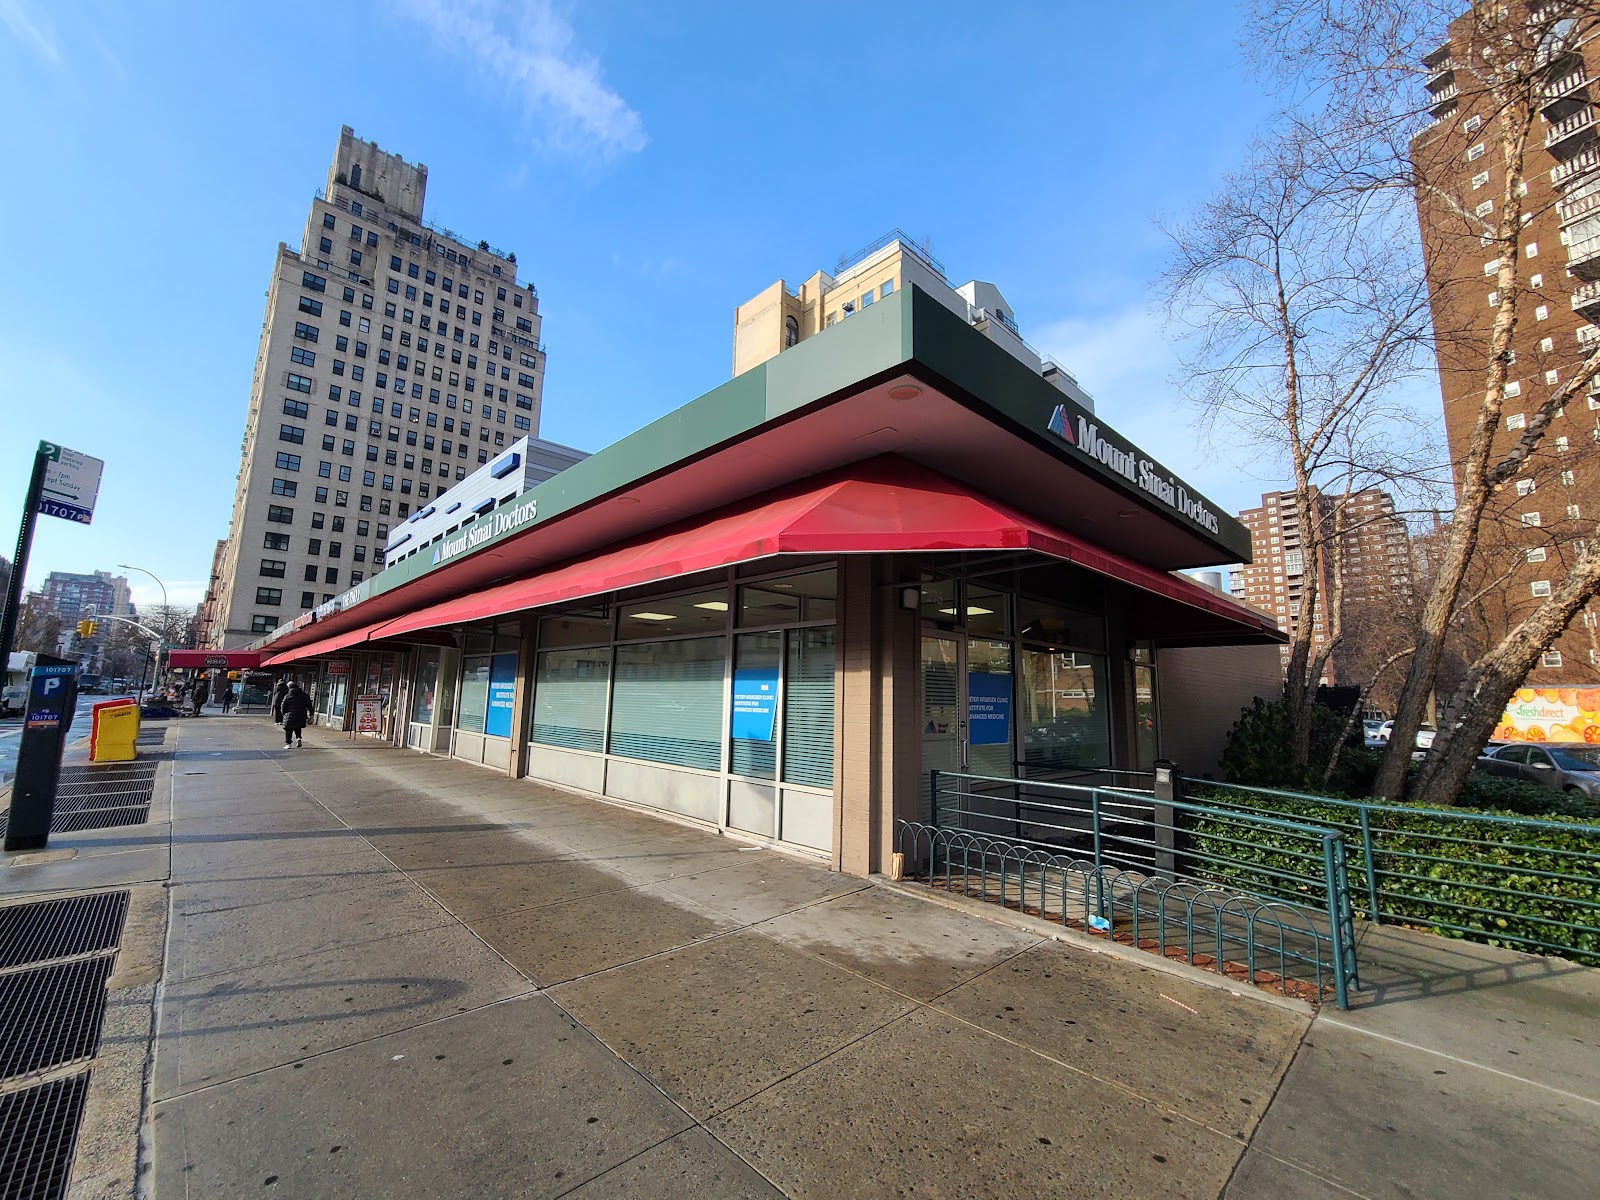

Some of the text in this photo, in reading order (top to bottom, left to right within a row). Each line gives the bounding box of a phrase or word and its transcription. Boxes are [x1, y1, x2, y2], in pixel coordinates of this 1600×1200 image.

[1077, 414, 1219, 535] Mount Sinai Doctors
[59, 480, 81, 491] Sunday
[441, 499, 538, 561] Mount Sinai Doctors
[43, 677, 60, 695] P
[1516, 704, 1564, 718] freshdirect
